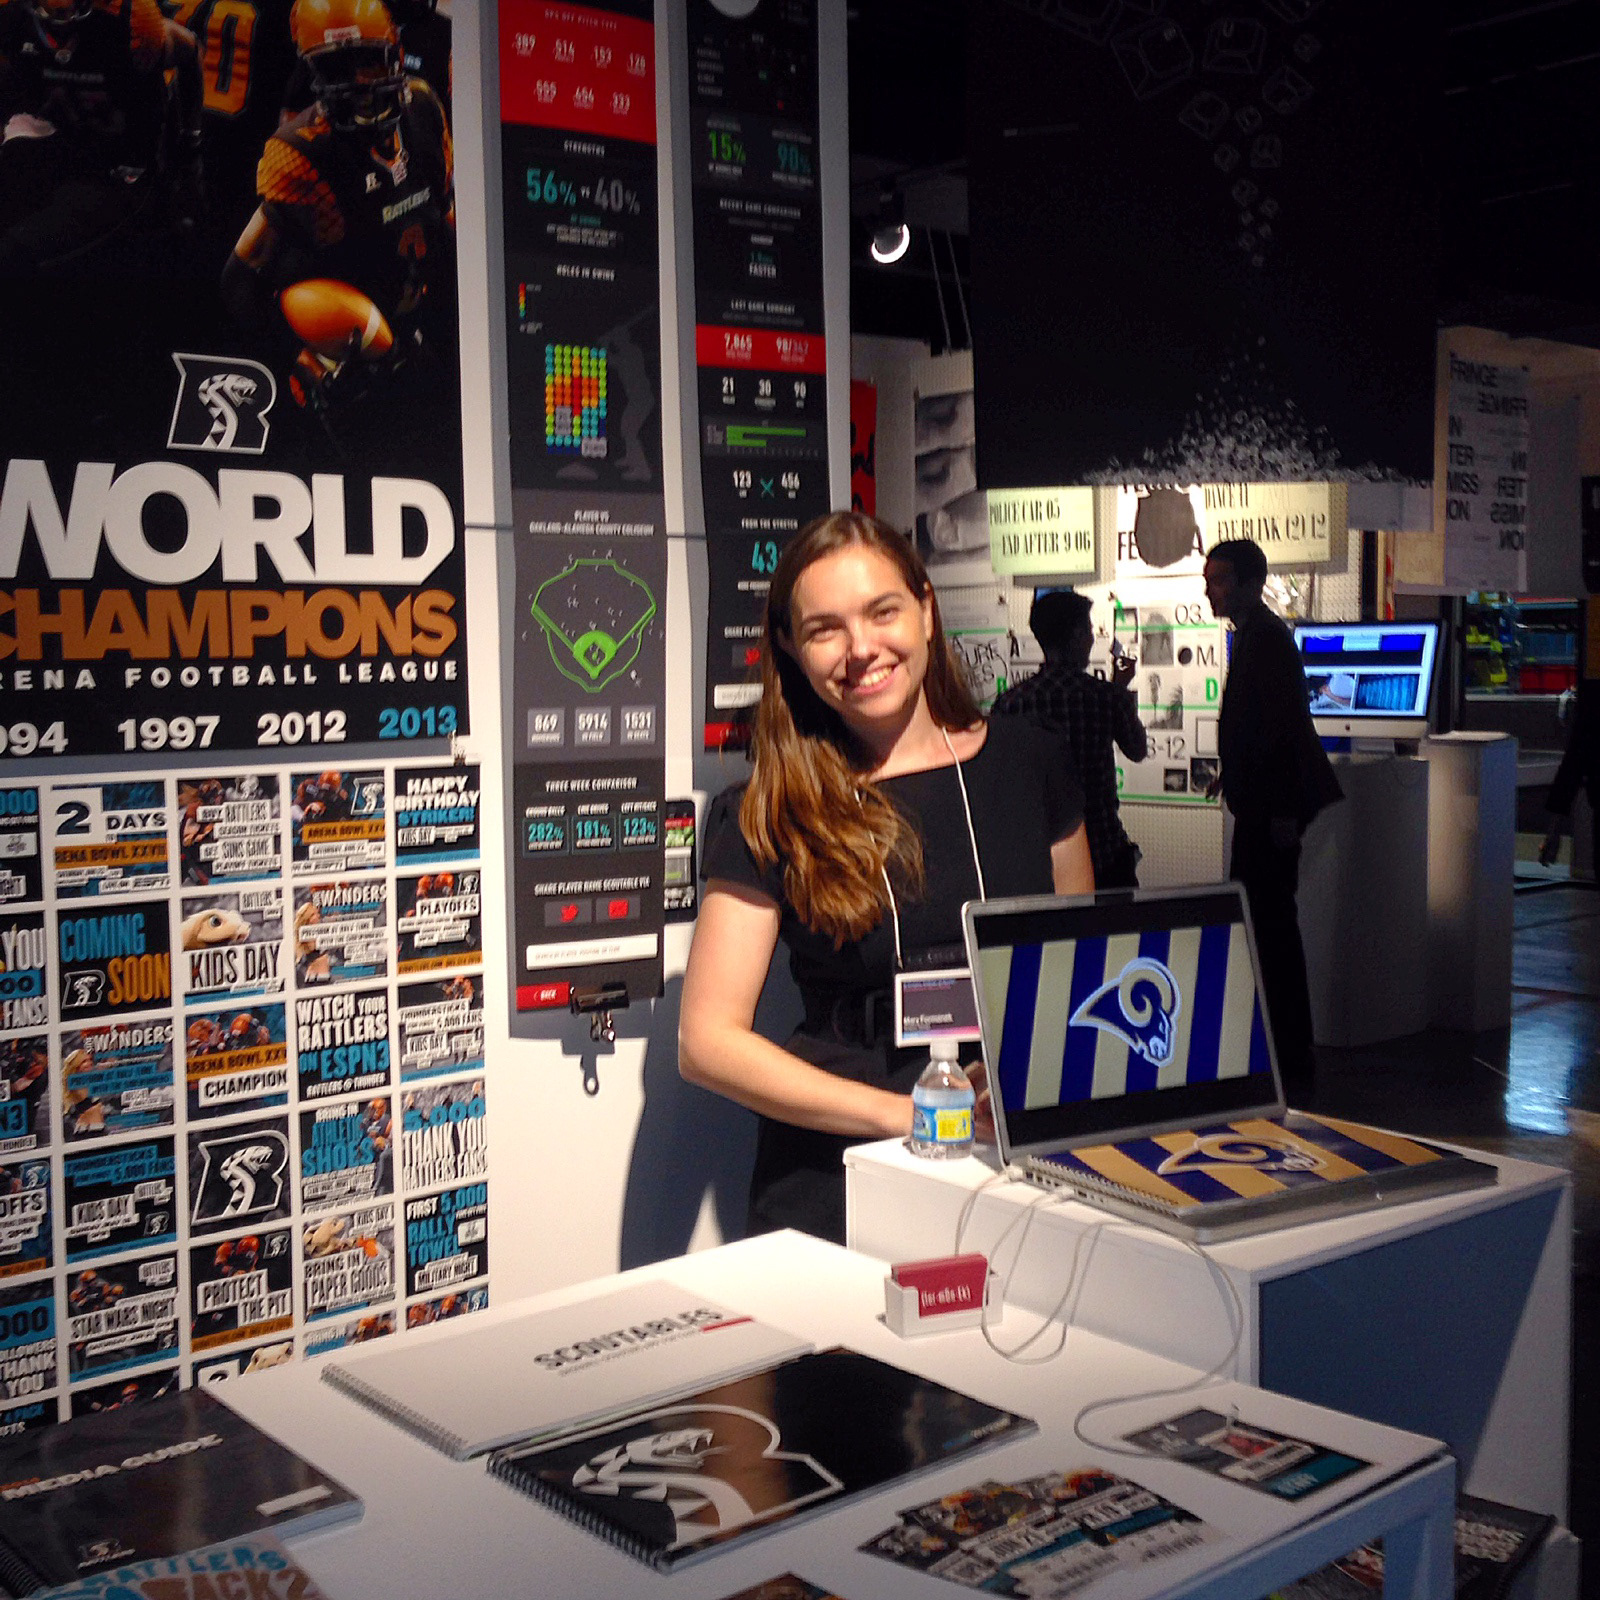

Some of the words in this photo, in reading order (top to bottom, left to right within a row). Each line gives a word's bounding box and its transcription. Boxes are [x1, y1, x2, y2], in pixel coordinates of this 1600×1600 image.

[709, 130, 746, 164] 15%
[526, 167, 576, 207] 56%
[594, 176, 641, 215] 40%
[722, 376, 734, 394] 21
[0, 459, 456, 585] WORLD
[1021, 499, 1043, 523] CAR
[1024, 531, 1059, 555] AFTER
[1242, 516, 1281, 543] BLINK
[125, 661, 318, 688] FOOTBALL
[339, 660, 458, 684] LEAGUE
[117, 715, 221, 752] 1997
[256, 709, 347, 746] 2012
[378, 705, 458, 740] 2013
[395, 789, 480, 812] BIRTHDAY
[407, 775, 468, 796] HAPPY
[546, 780, 570, 793] THREE
[570, 778, 591, 792] WEEK
[592, 777, 638, 791] COMPARISON
[56, 801, 92, 835] 2
[107, 811, 167, 831] DAYS
[397, 805, 476, 828] STRIKER!
[246, 839, 269, 857] GAME
[534, 882, 558, 897] SHARE
[558, 880, 583, 895] PLAYER
[584, 879, 603, 892] NAME
[639, 876, 650, 888] VIA
[421, 897, 477, 915] PLAYOFFS
[1, 928, 46, 972] YOU
[60, 912, 147, 964] COMING
[107, 952, 170, 1006] SOON
[191, 948, 238, 988] KIDS
[245, 943, 280, 982] DAY
[297, 993, 356, 1025] WATCH
[357, 995, 387, 1016] YOUR
[540, 989, 556, 1001] BACK
[3, 997, 48, 1030] FANS!
[462, 1010, 482, 1024] FANS
[298, 1014, 388, 1051] RATTLERS
[228, 1050, 260, 1067] BOWL
[299, 1052, 318, 1073] ON
[320, 1040, 391, 1080] ESPN3
[306, 1080, 343, 1099] RATTLERS
[353, 1072, 386, 1090] THUNDER
[316, 1103, 347, 1123] BRING
[347, 1101, 360, 1117] IN
[312, 1113, 364, 1149] ATHLETIC
[402, 1120, 456, 1169] THANK
[457, 1114, 487, 1155] YOU
[302, 1137, 376, 1178] SHOES
[403, 1154, 456, 1193] RATTLERS
[78, 1201, 106, 1224] KIDS
[108, 1196, 130, 1218] DAY
[357, 1211, 374, 1225] KIDS
[376, 1208, 390, 1222] DAY
[406, 1197, 438, 1221] FIRST
[441, 1183, 487, 1215] 5,000
[407, 1212, 458, 1247] RALLY
[304, 1256, 344, 1279] BRING
[347, 1252, 362, 1269] IN
[408, 1233, 462, 1268] TOWEL
[311, 1275, 347, 1304] PAPER
[350, 1263, 387, 1294] GOODS
[418, 1266, 452, 1284] MILITARY
[454, 1258, 475, 1278] NIGHT
[204, 1275, 262, 1309] PROTECT
[71, 1313, 103, 1340] STAR
[104, 1305, 139, 1331] WARS
[142, 1298, 174, 1323] NIGHT
[242, 1298, 266, 1323] THE
[269, 1293, 287, 1319] PIT
[6, 1373, 45, 1398] YOU
